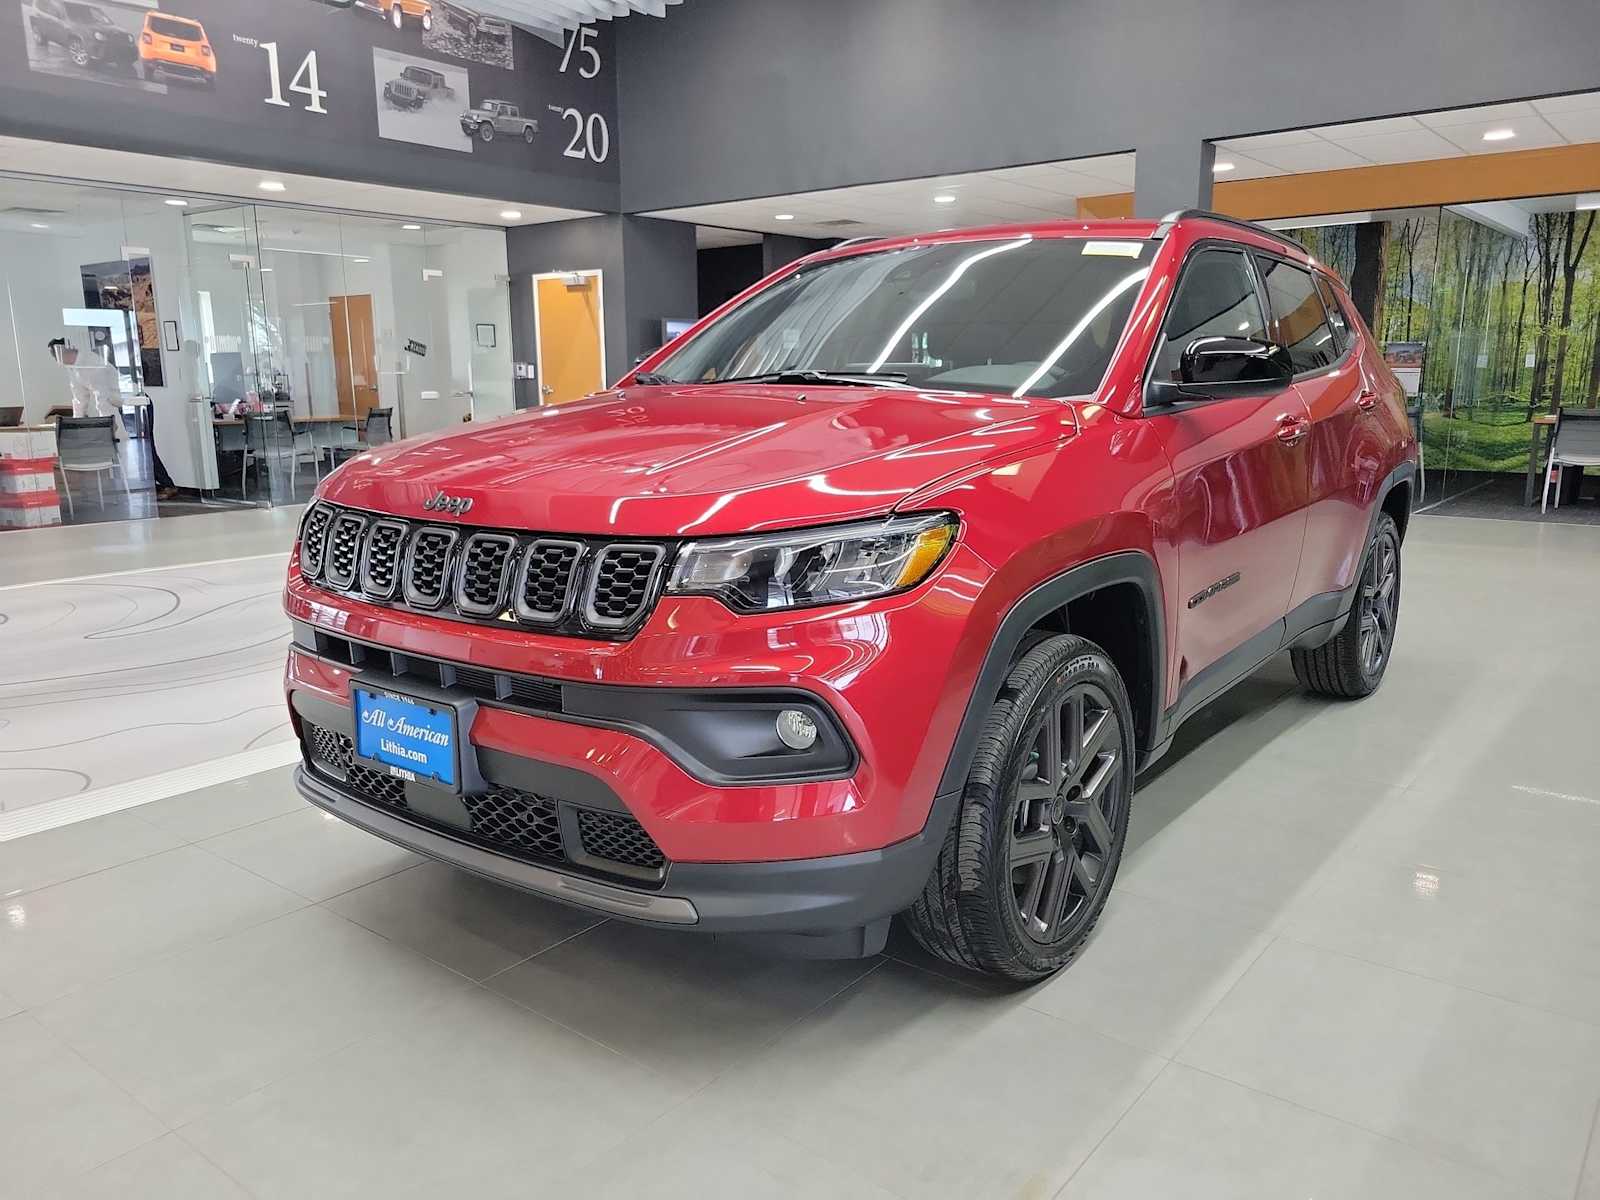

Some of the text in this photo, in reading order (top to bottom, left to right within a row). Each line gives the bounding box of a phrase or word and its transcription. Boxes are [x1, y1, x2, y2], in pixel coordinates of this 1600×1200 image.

[259, 41, 328, 114] 14
[562, 107, 609, 163] 20
[423, 490, 473, 517] Jeep
[361, 709, 449, 746] All American
[380, 738, 428, 764] Lithia.com
